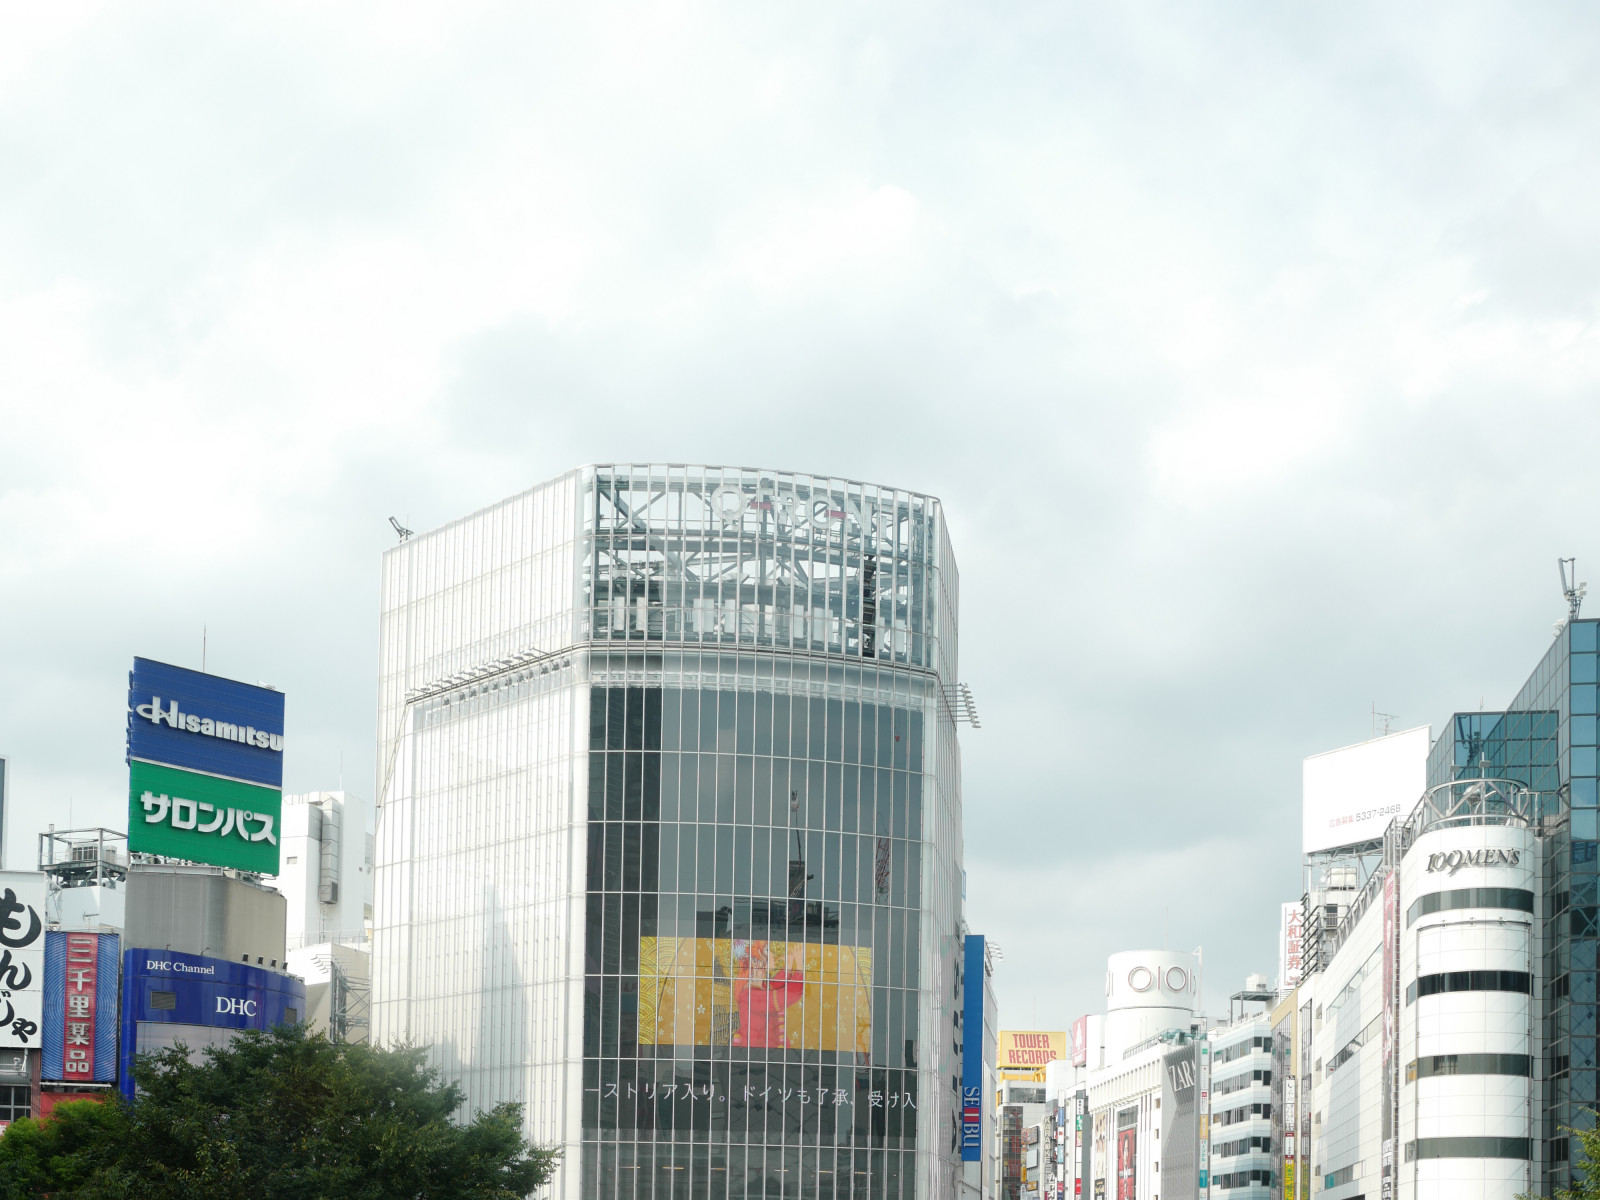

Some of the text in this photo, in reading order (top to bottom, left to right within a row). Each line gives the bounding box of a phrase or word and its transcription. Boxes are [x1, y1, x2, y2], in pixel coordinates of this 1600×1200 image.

[136, 696, 283, 752] Hisamitsu
[141, 790, 277, 846] サロンパス
[1287, 908, 1302, 970] 大和証券
[146, 960, 215, 975] DHC Channel
[65, 938, 92, 1073] 三千里薬品
[216, 996, 257, 1017] DHC
[1008, 1050, 1057, 1064] RECORDS
[1012, 1034, 1050, 1049] TOWER
[963, 1086, 980, 1148] SEIBU
